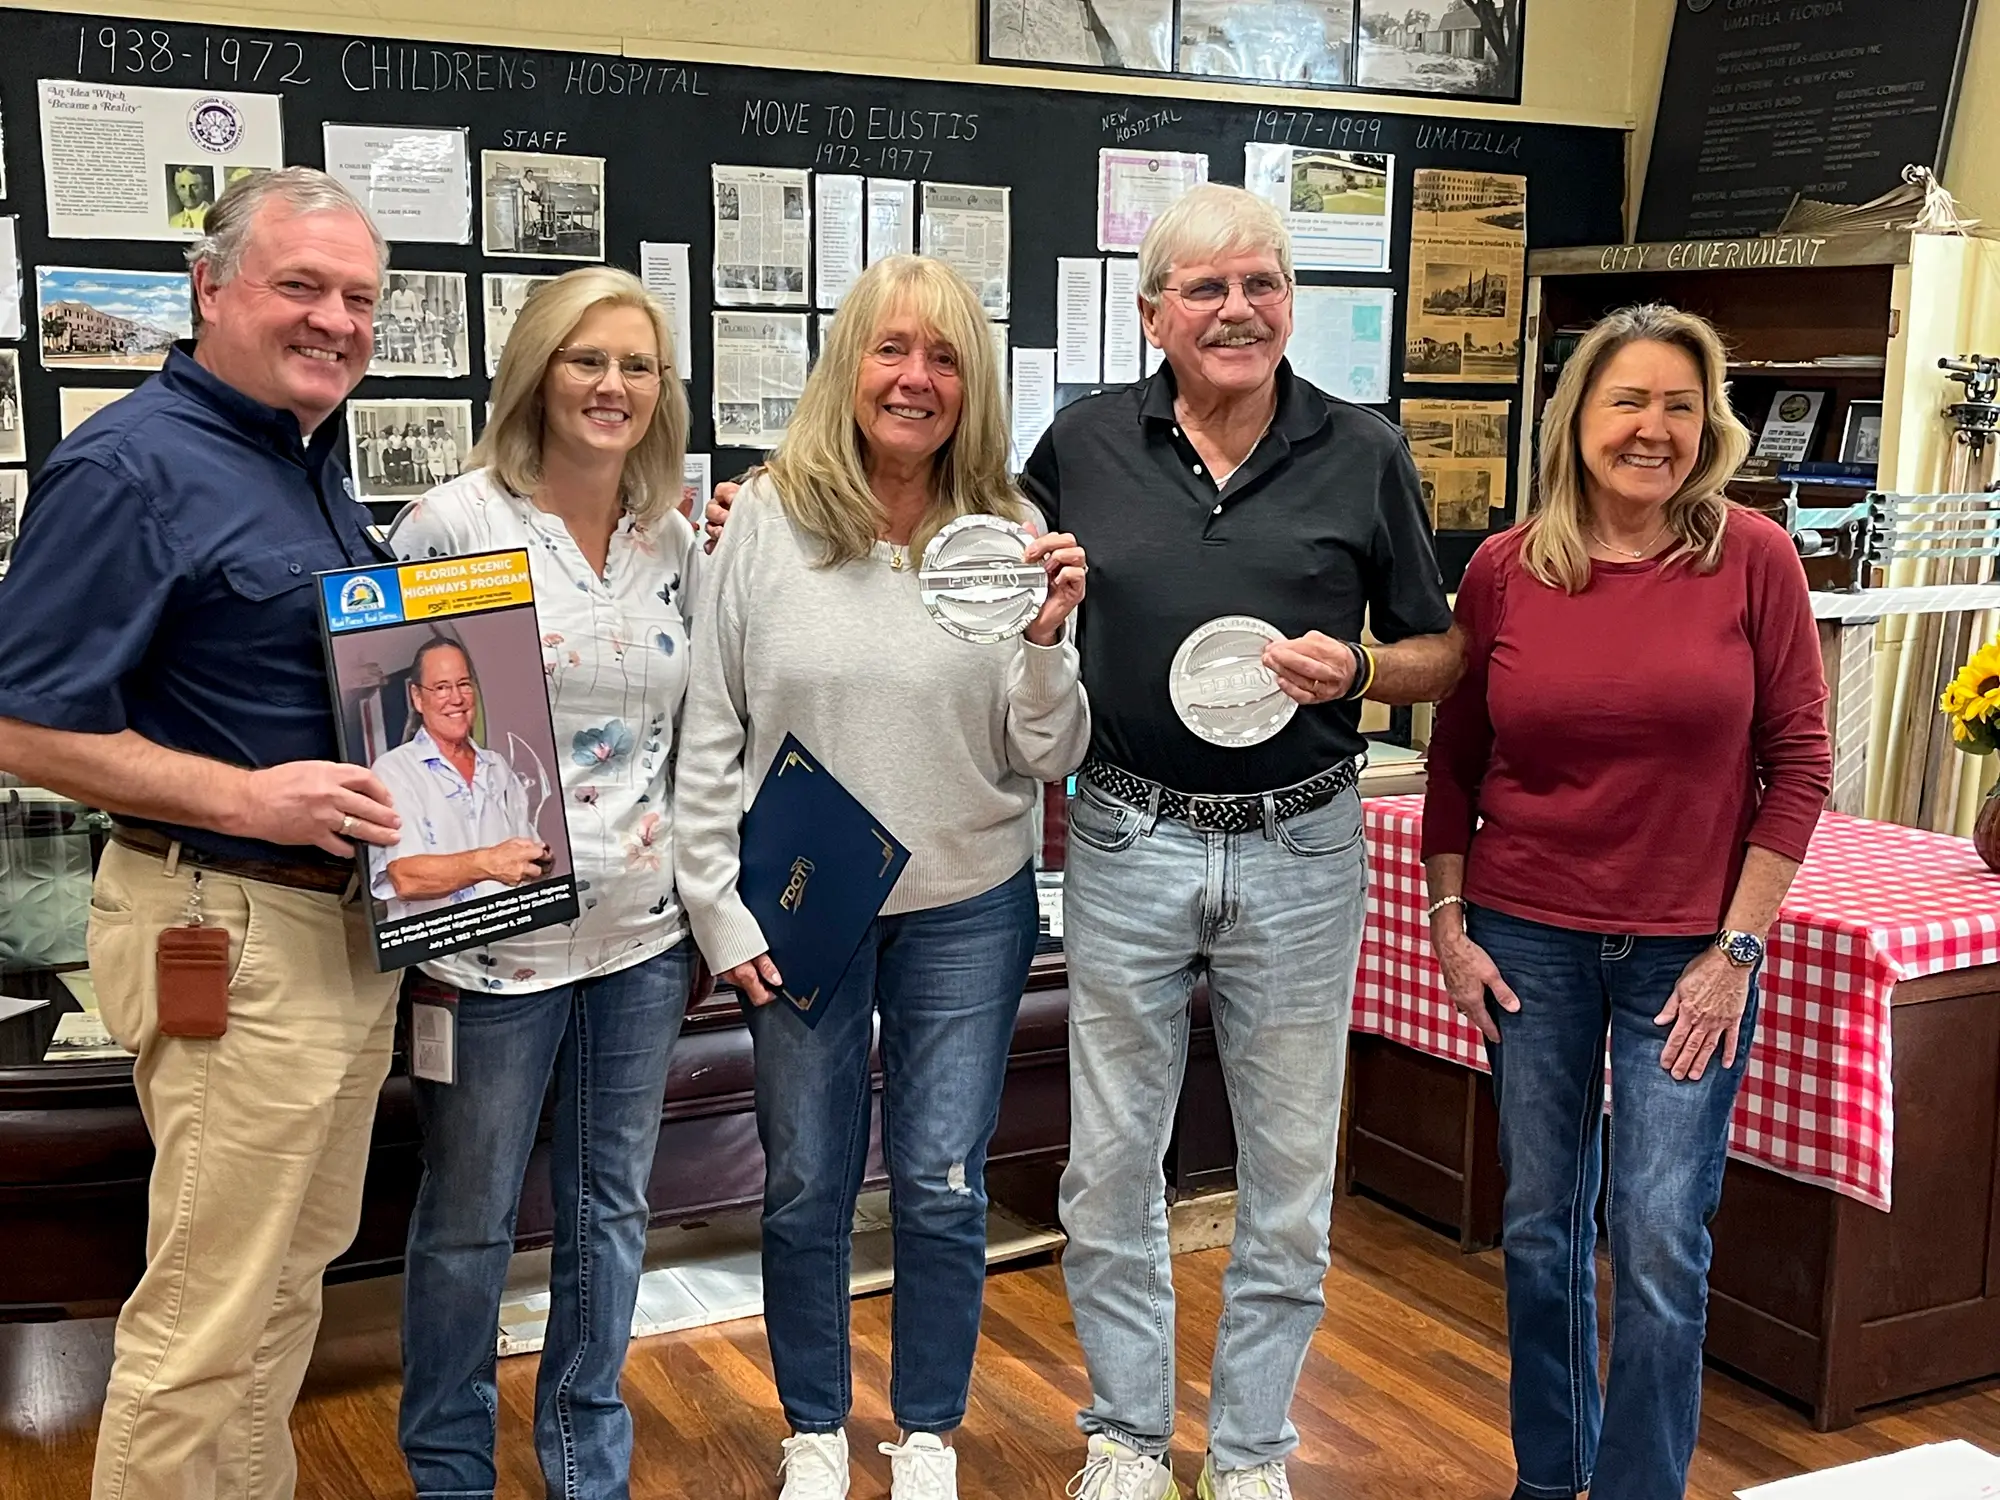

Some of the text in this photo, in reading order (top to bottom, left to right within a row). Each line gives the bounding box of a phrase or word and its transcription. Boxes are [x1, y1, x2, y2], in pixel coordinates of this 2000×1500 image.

[1789, 1, 1844, 21] FLORIDA
[78, 26, 311, 85] 1938-1972
[341, 40, 709, 96] CHILDRENS HOSPITAL
[48, 99, 90, 109] Became
[100, 101, 142, 114] Reality
[67, 87, 90, 97] Idea
[92, 88, 126, 101] Which
[741, 100, 979, 140] MOVE TO EUSTIS
[1101, 107, 1128, 132] NEW
[1116, 109, 1182, 143] HOSPITAL
[1253, 109, 1383, 147] 1977-1999
[503, 129, 567, 149] STAFF
[1415, 124, 1522, 158] UMATILLA
[815, 142, 933, 174] 1972-1977
[1600, 238, 1826, 270] CITY GOVERNMENT
[403, 572, 529, 599] HIGHWAYS PROGRAM
[416, 559, 512, 581] FLORIDA SCENIC
[495, 897, 518, 908] Florida
[518, 891, 539, 902] Scenic
[540, 884, 570, 896] Highways
[779, 870, 806, 909] FDOT
[390, 938, 402, 946] the
[403, 931, 429, 943] Florida
[429, 924, 452, 936] Scenic
[452, 917, 480, 929] Highway
[481, 906, 520, 921] Coordinator
[531, 896, 554, 908] District
[429, 940, 443, 950] July
[476, 922, 508, 936] December
